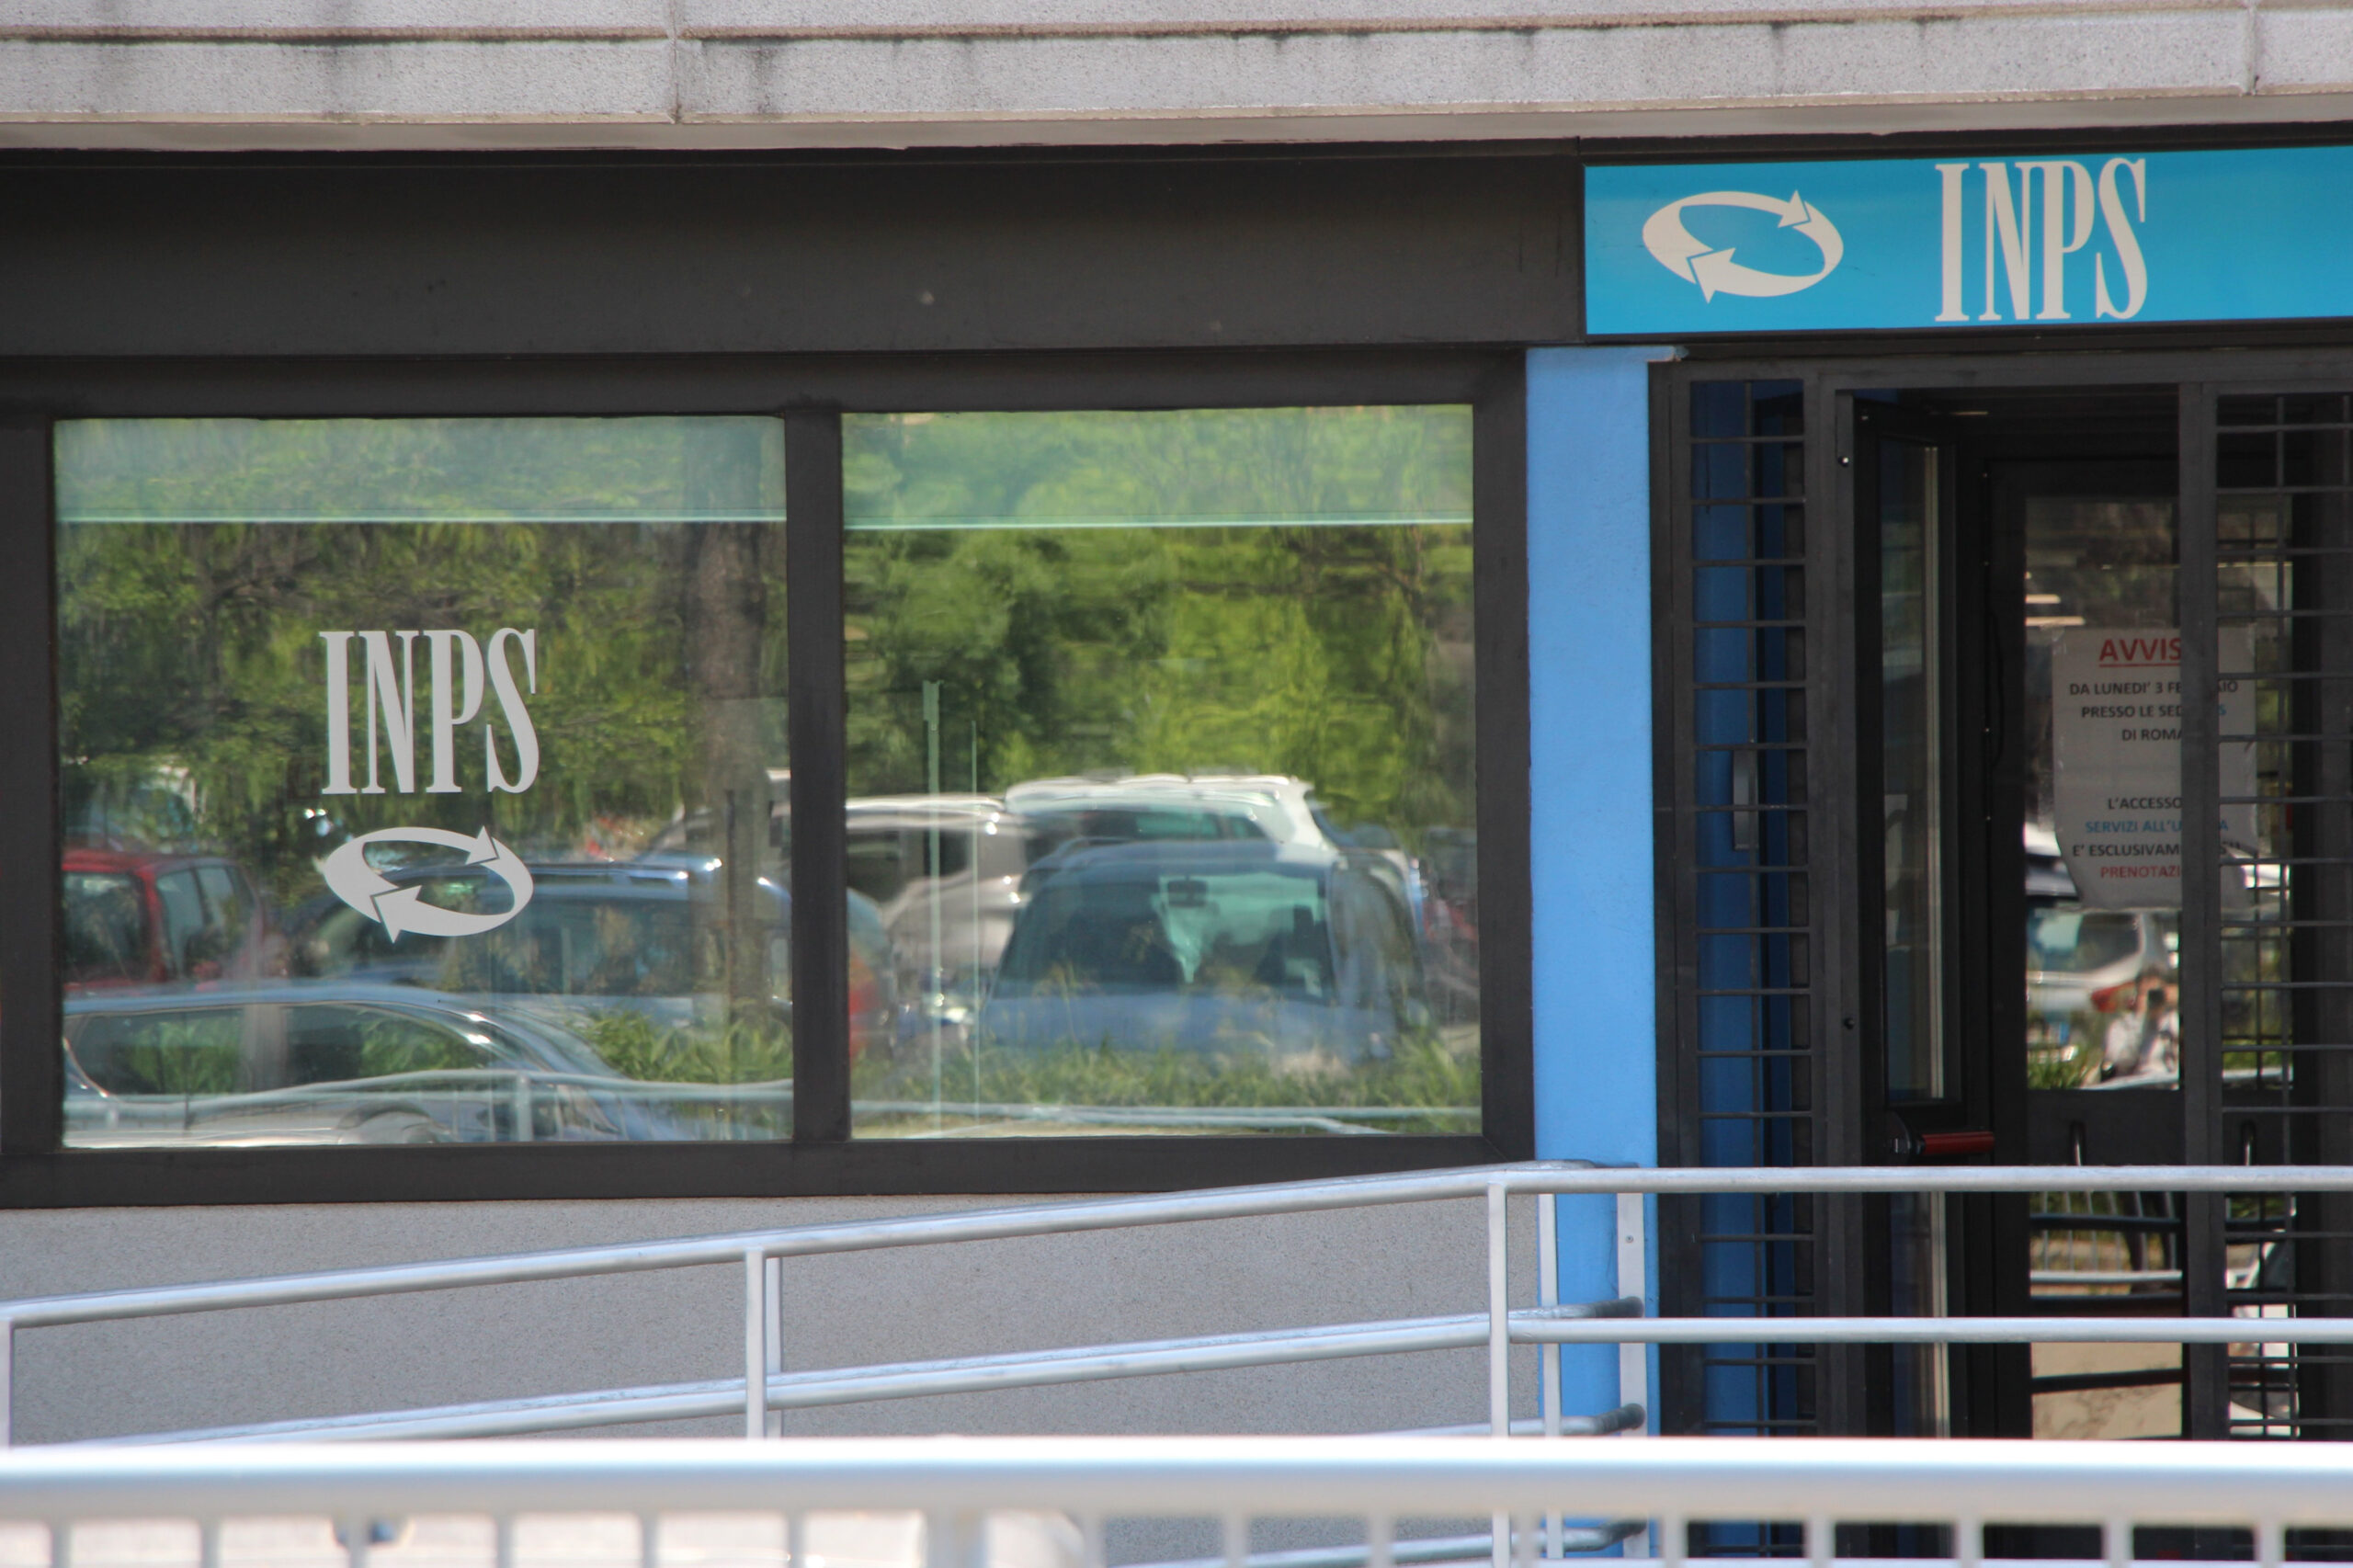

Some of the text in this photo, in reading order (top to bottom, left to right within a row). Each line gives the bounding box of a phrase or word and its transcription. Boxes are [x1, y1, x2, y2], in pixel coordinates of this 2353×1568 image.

[1935, 157, 2148, 322] INPS
[2099, 637, 2182, 662] AVVIS
[2069, 683, 2090, 695] DA
[2095, 682, 2151, 695] LUNEDI'
[2155, 682, 2164, 694] 3
[319, 628, 540, 794] INPS
[2082, 705, 2135, 717] PRESSO
[2140, 705, 2154, 717] LE
[2122, 729, 2137, 741] DI
[2108, 797, 2184, 810] L'ACCESSO
[2085, 821, 2138, 834] SERVIZI
[2073, 844, 2085, 857] E'
